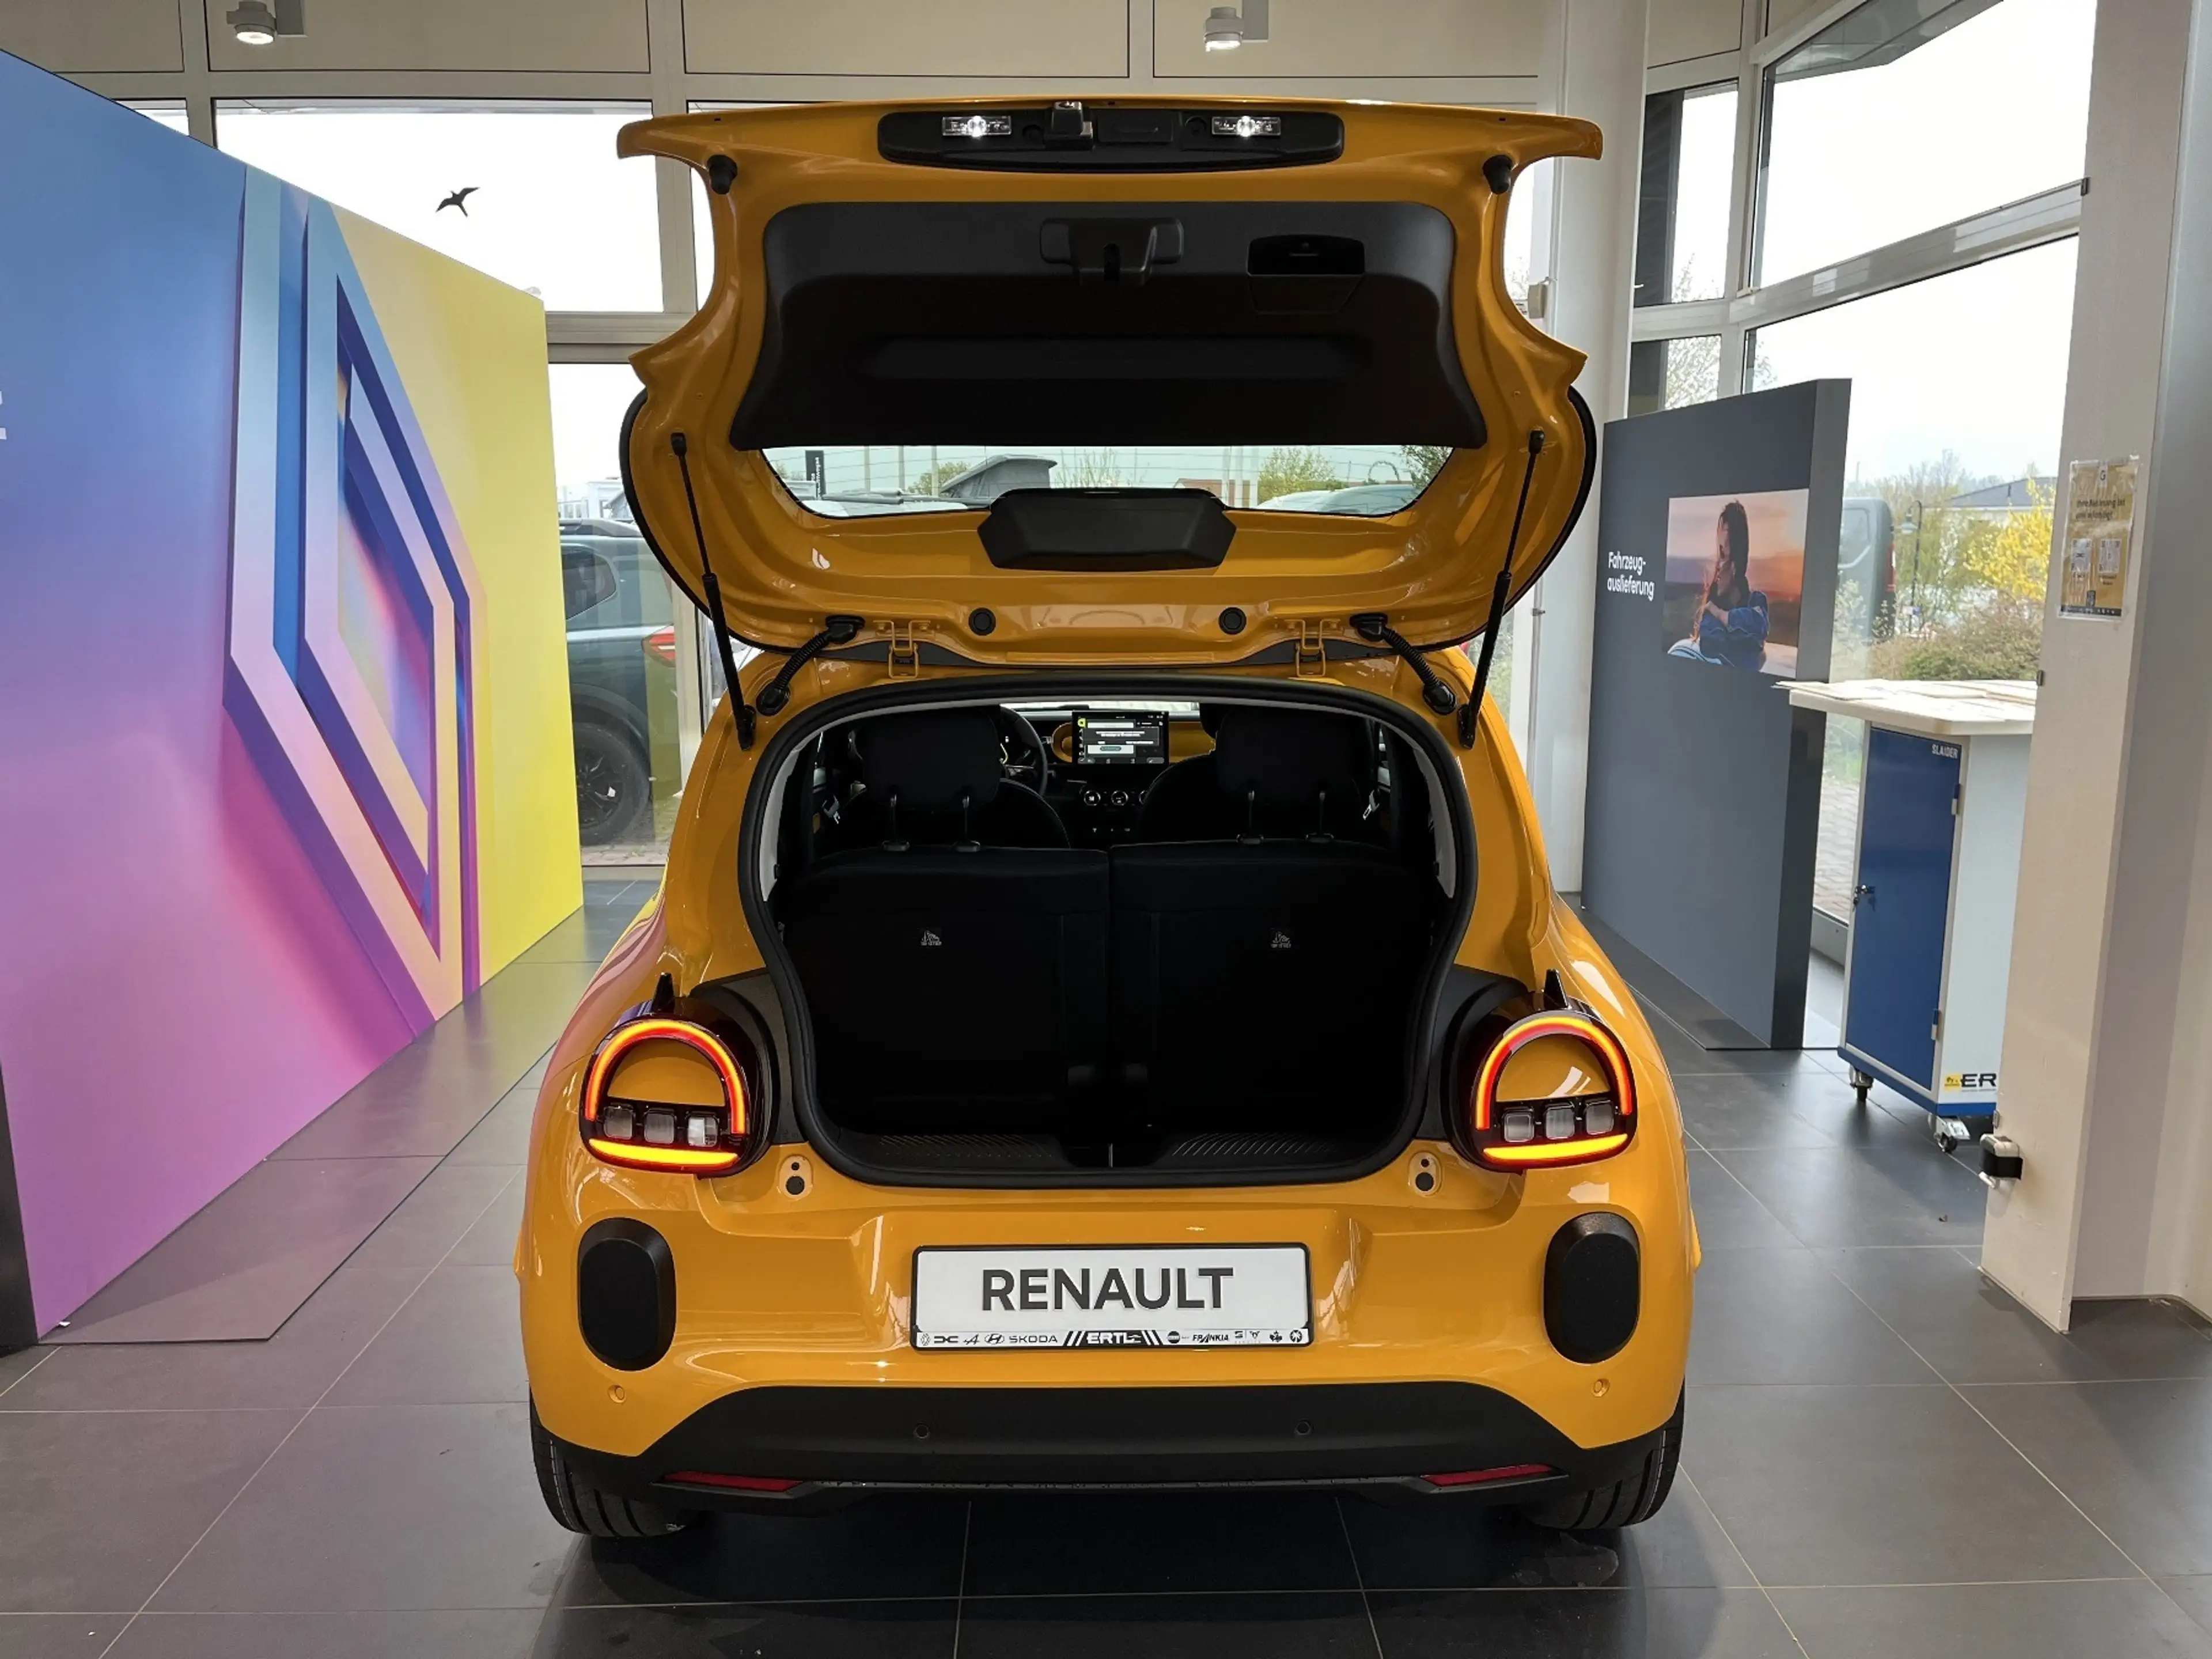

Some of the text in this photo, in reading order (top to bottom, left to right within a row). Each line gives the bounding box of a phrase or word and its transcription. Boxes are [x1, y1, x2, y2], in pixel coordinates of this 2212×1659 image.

[1608, 551, 1646, 575] Fahrzeug-
[1607, 574, 1655, 601] auslieferung
[982, 1267, 1233, 1312] RENAULT
